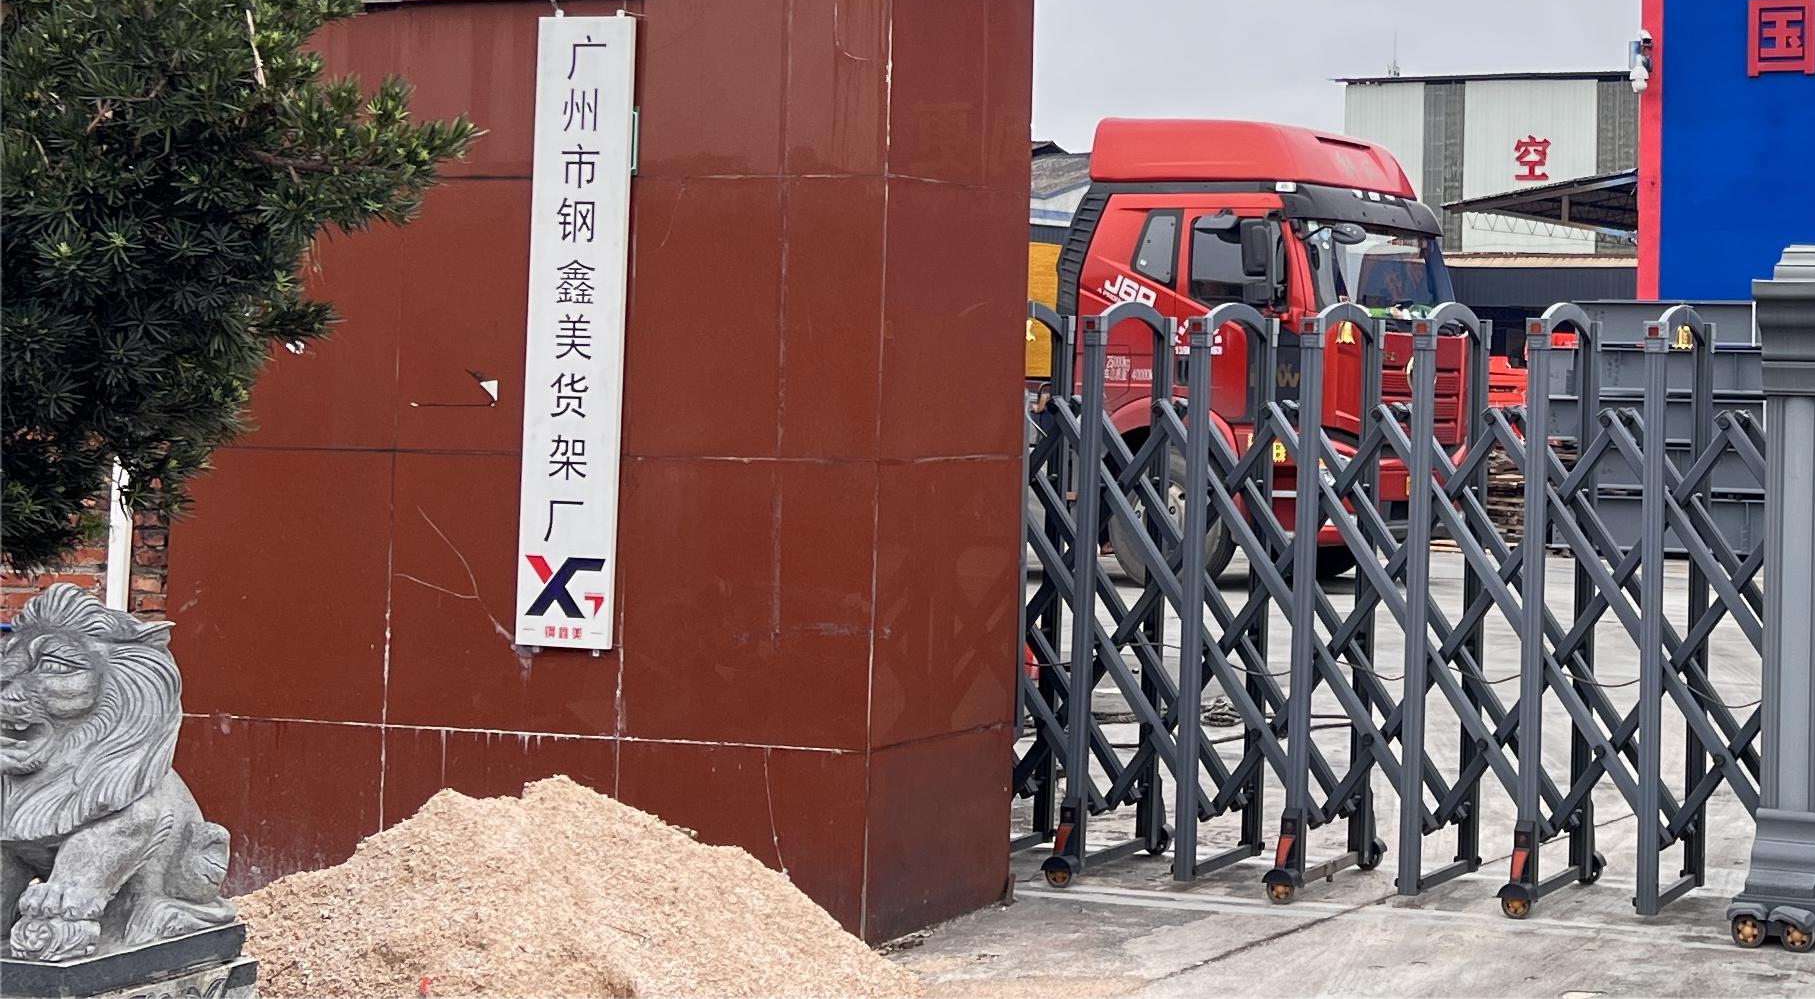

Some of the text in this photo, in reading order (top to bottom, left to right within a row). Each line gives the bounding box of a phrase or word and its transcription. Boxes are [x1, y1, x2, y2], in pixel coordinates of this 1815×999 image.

[543, 35, 608, 542] 广州市钢鑫美货架厂
[1514, 134, 1552, 181] 空
